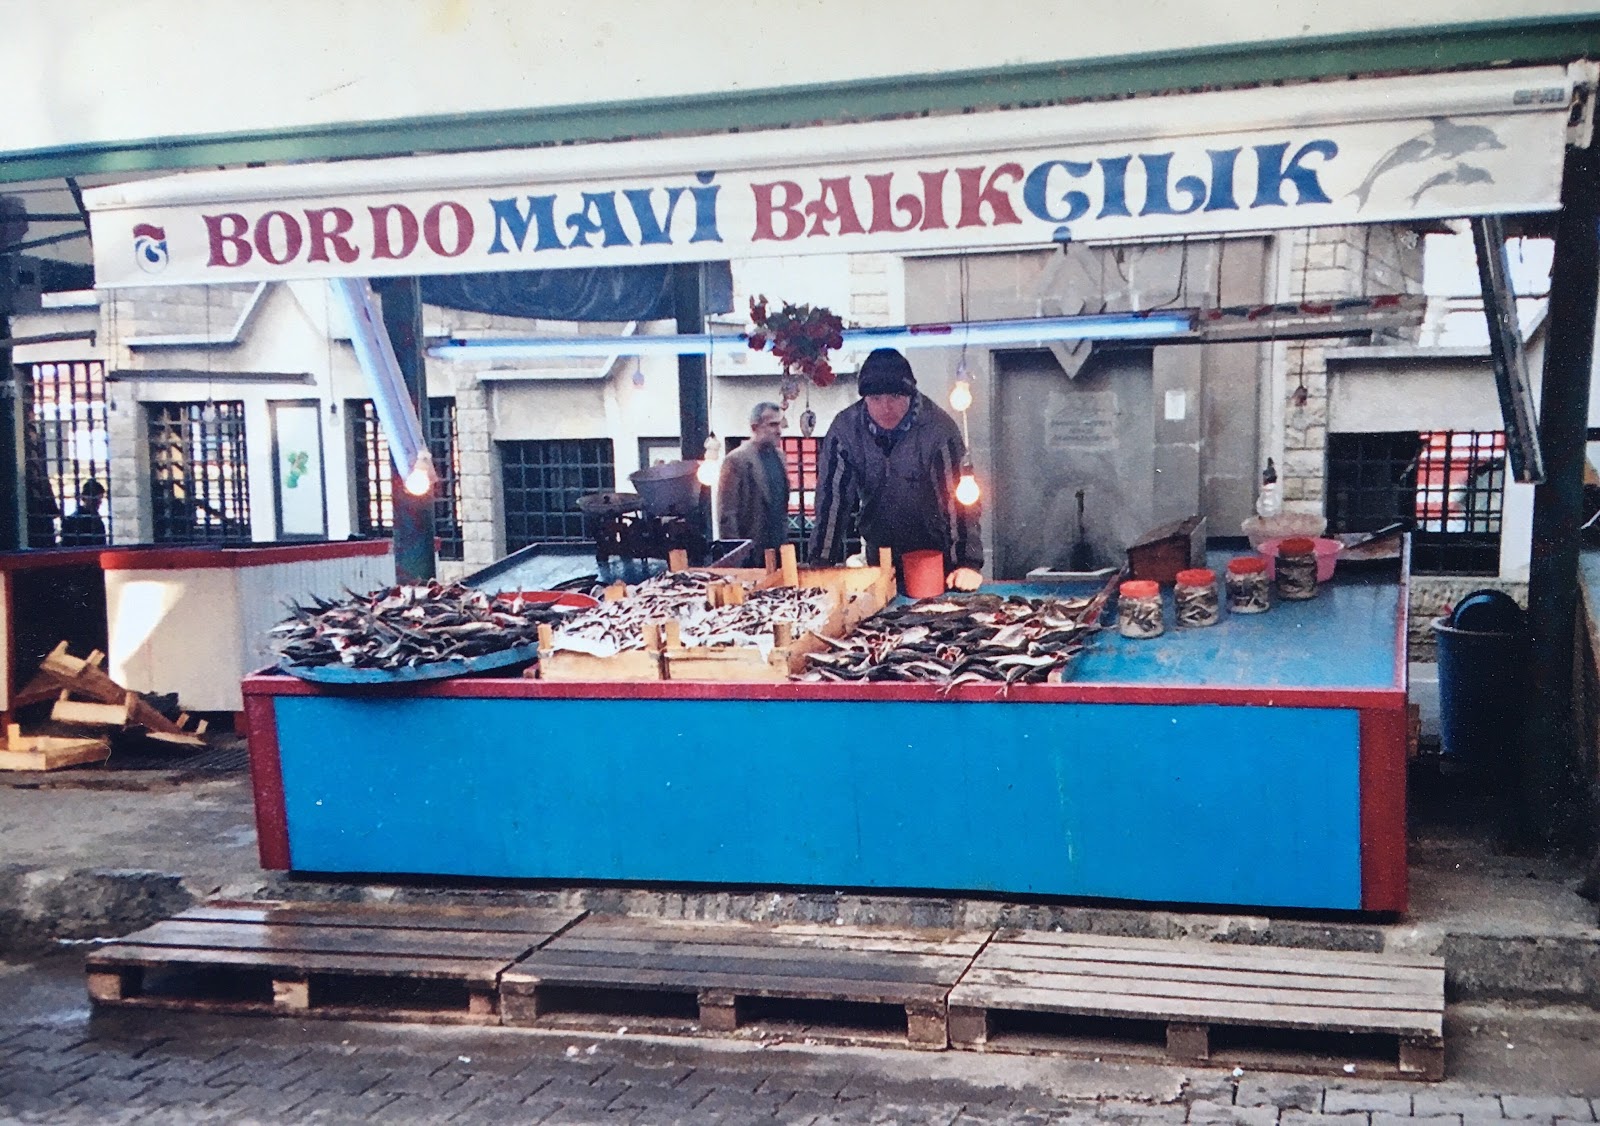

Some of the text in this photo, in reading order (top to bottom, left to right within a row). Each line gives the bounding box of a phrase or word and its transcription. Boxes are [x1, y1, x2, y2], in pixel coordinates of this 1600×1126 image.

[202, 139, 1338, 268] BORDO MAVİ BALIKÇILIK
